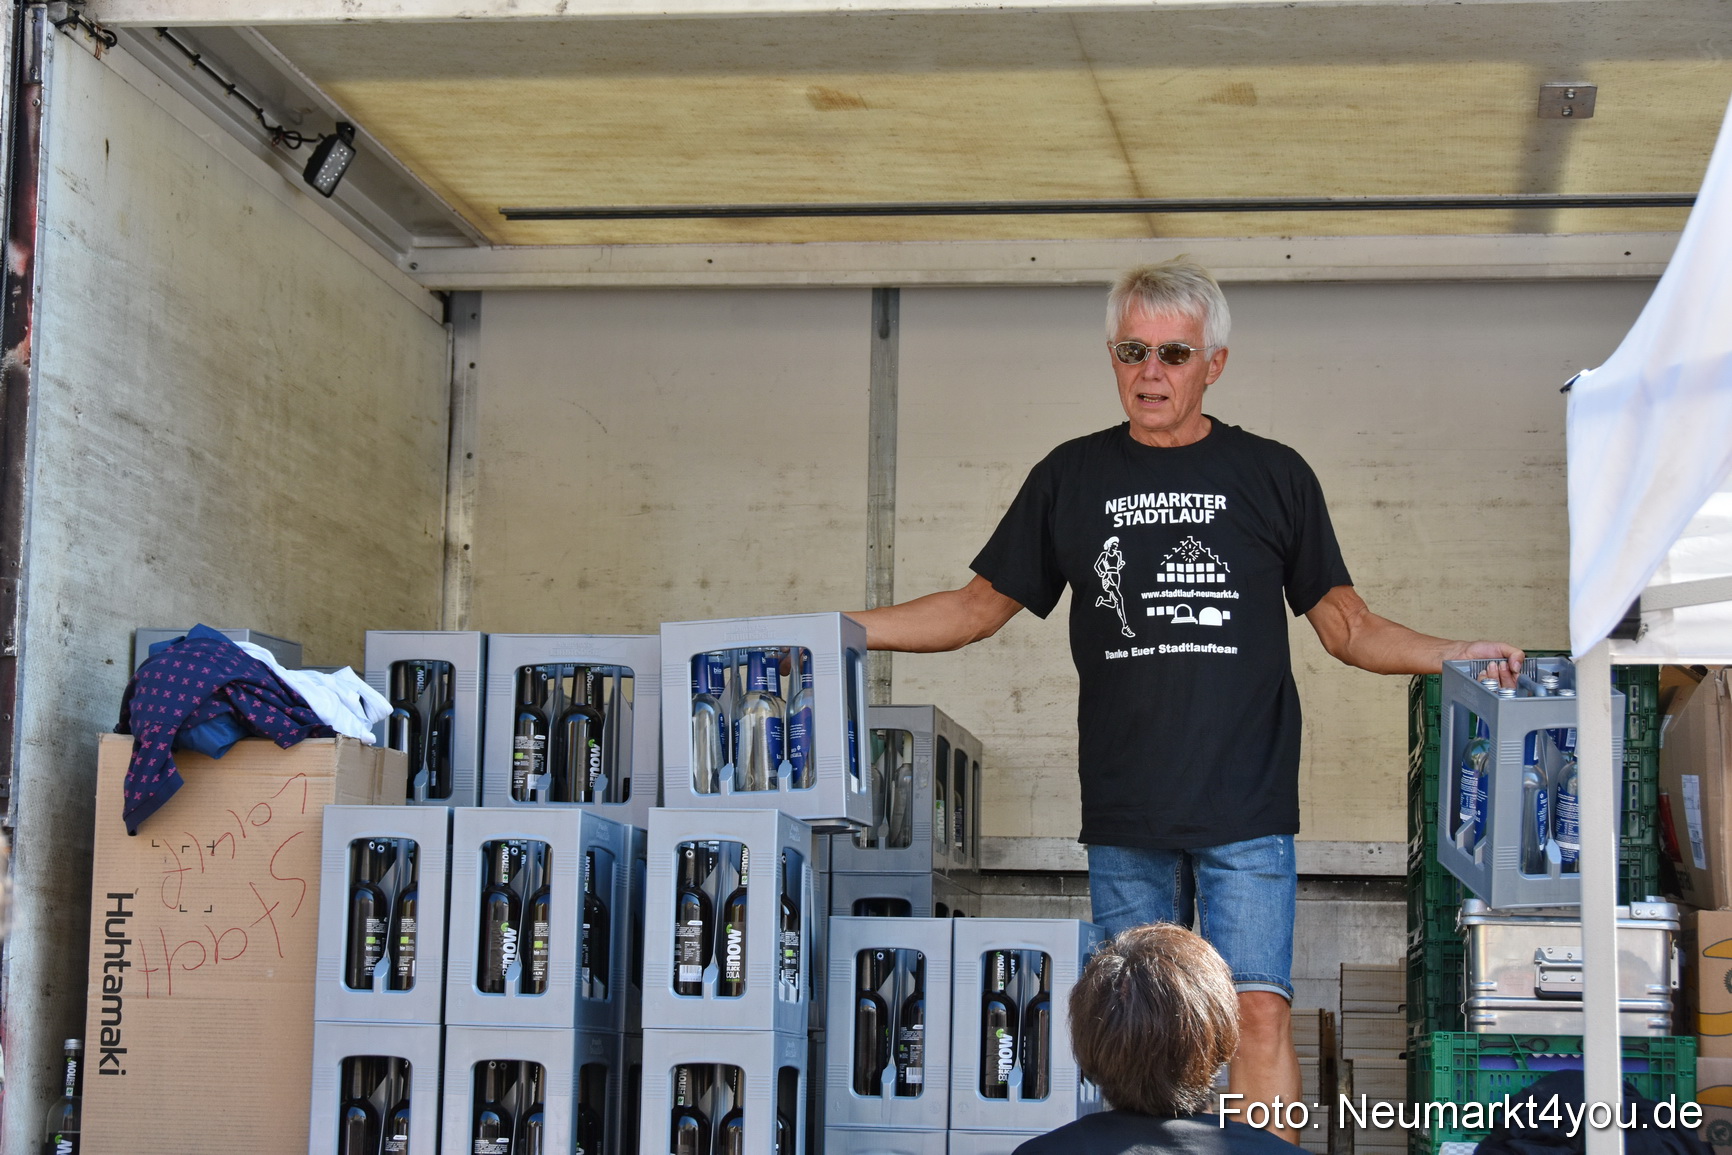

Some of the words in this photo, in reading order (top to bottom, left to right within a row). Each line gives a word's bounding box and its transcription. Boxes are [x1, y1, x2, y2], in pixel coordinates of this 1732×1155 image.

[1105, 492, 1227, 514] NEUMARKTER
[1113, 508, 1215, 528] STADTLAUF
[1141, 589, 1239, 600] www.stadtlauf-neumarkt.de
[1131, 647, 1155, 657] Euer
[590, 743, 600, 775] now
[502, 927, 517, 963] now
[727, 929, 742, 965] now
[98, 893, 134, 1075] Huhtamaki
[998, 1033, 1013, 1069] now
[67, 1060, 76, 1081] now
[678, 1068, 688, 1089] now
